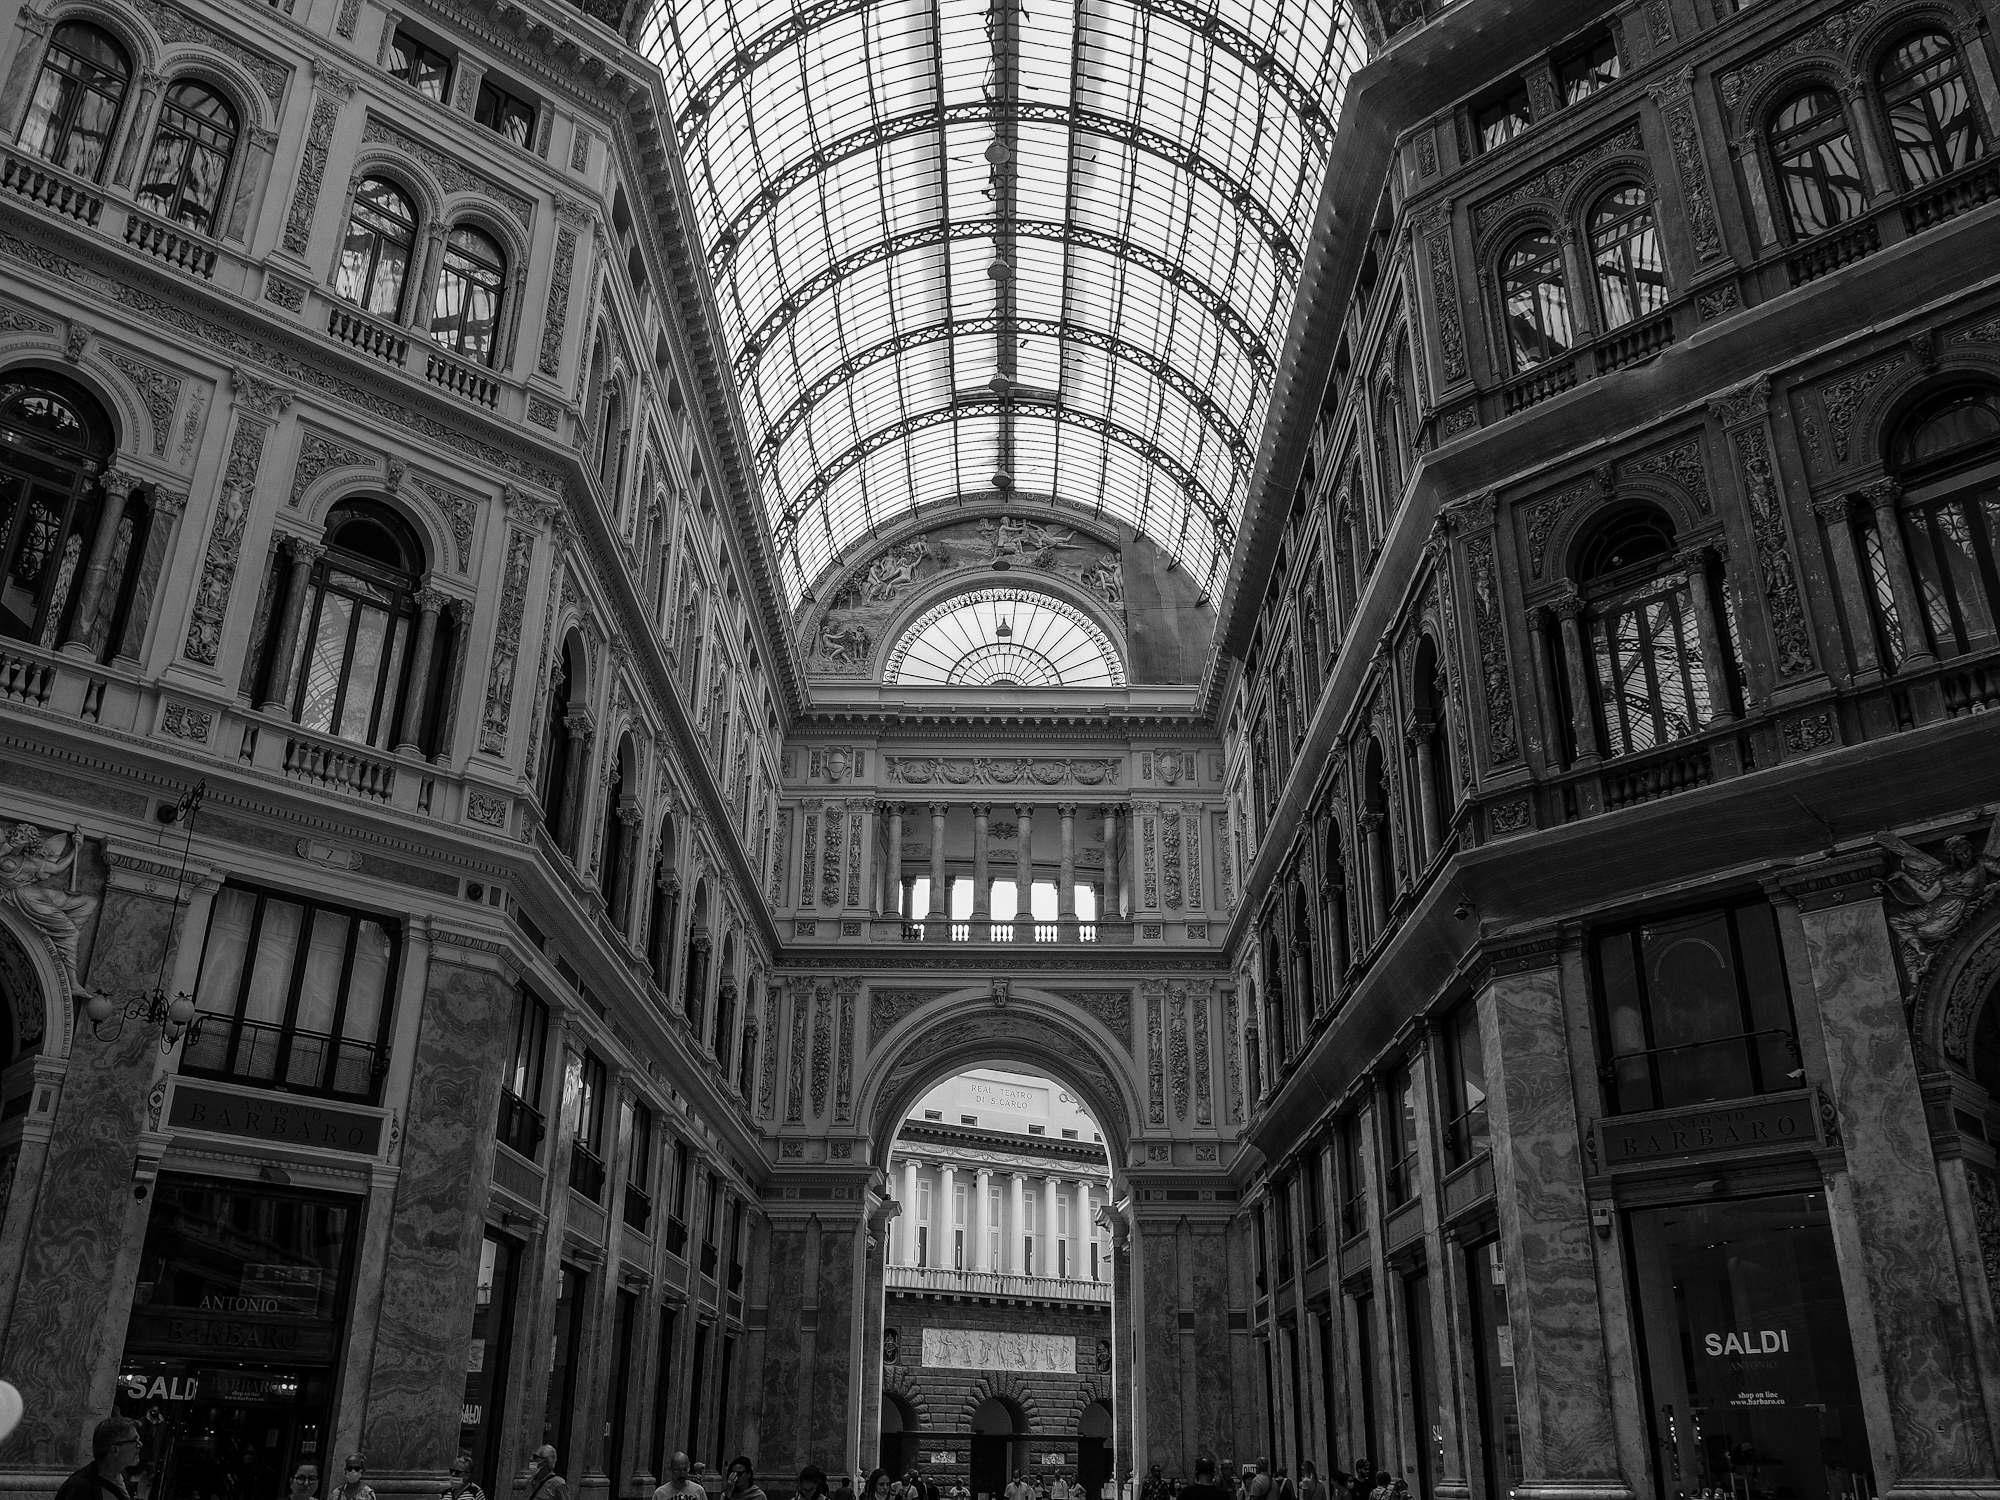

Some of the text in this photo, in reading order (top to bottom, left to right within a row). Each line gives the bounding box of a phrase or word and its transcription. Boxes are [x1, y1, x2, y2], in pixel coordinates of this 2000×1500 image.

[326, 848, 334, 860] 7
[971, 1084, 1033, 1100] REAL TEATRO
[976, 1095, 985, 1103] DI
[240, 1099, 322, 1121] ANTONIO
[190, 1102, 364, 1146] BARBARO
[1666, 1111, 1745, 1131] ANTONIO
[1623, 1116, 1795, 1156] BARBARO
[199, 1295, 278, 1313] ANTONIO
[167, 1319, 298, 1350] BARBARO
[1704, 1329, 1790, 1356] SALDI
[1729, 1360, 1778, 1371] ANTONIO
[210, 1377, 280, 1394] BARBARO
[1729, 1398, 1786, 1406] www.barbaro.eu
[1737, 1391, 1754, 1399] shop
